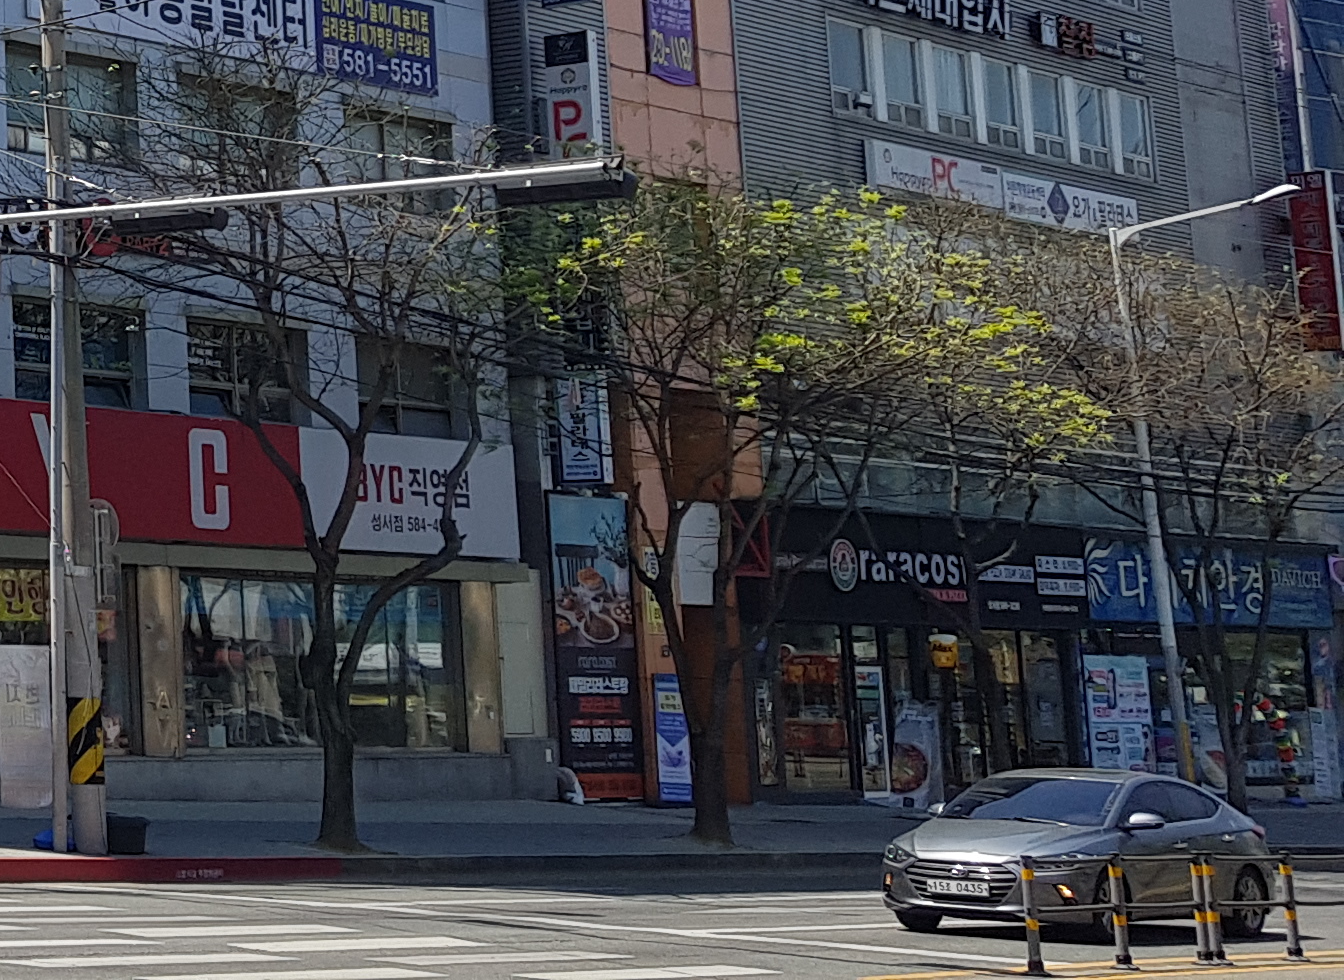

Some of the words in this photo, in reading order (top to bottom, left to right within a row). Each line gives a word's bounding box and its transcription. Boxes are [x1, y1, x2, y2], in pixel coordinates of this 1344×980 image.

[342, 47, 433, 89] 581-5551
[370, 513, 405, 534] 성서점
[1270, 568, 1322, 590] DAVICH
